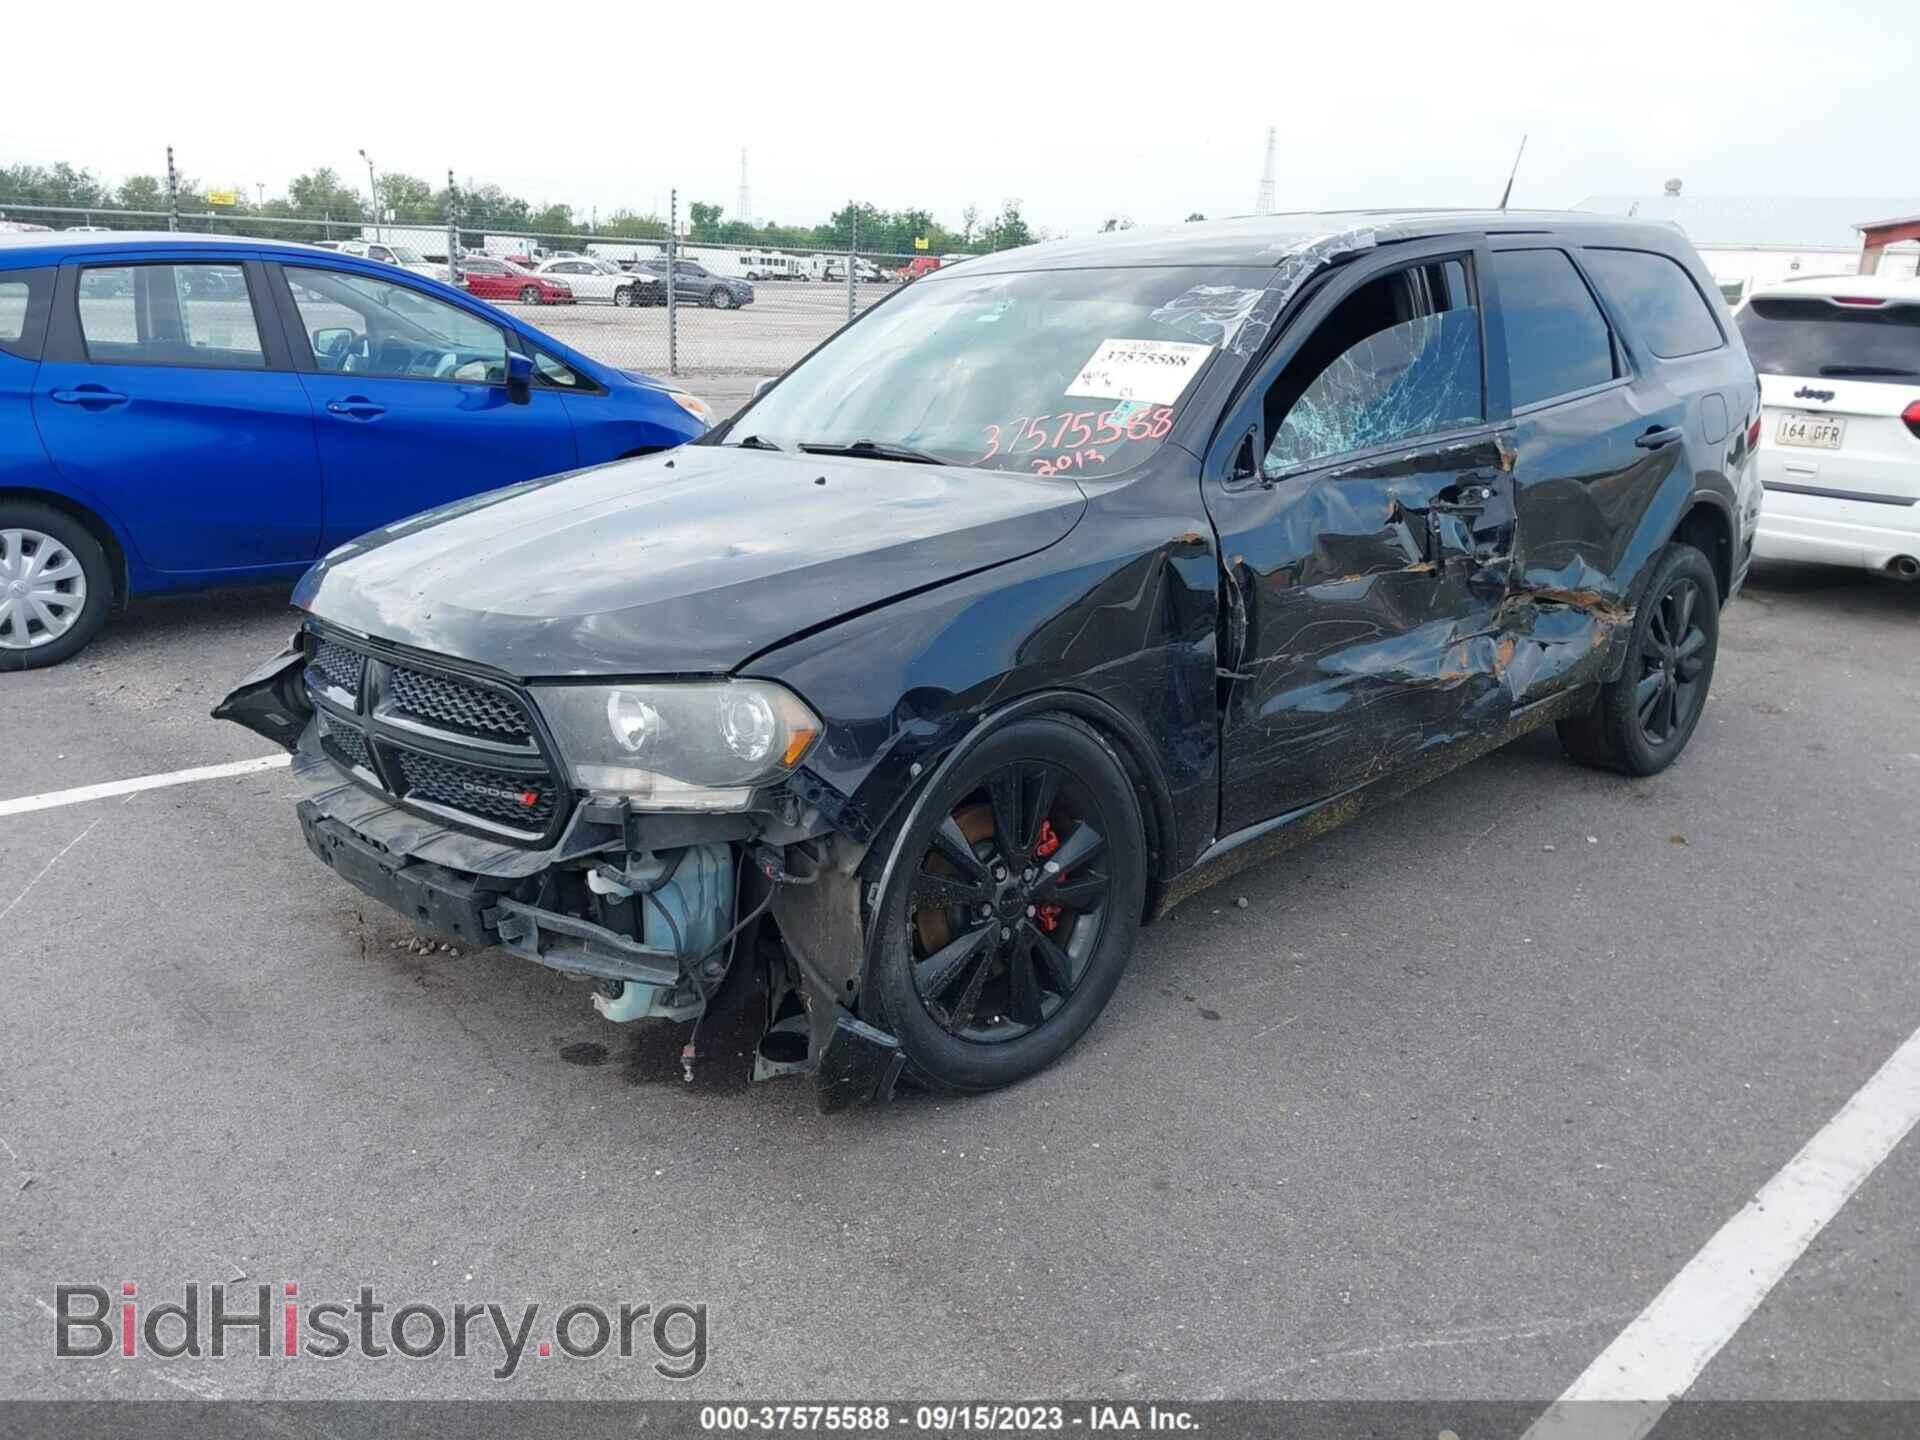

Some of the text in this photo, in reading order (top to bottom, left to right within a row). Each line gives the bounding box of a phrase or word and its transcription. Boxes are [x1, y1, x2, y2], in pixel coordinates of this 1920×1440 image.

[1793, 385, 1835, 403] Jeep
[1782, 422, 1840, 441] 164 GFR
